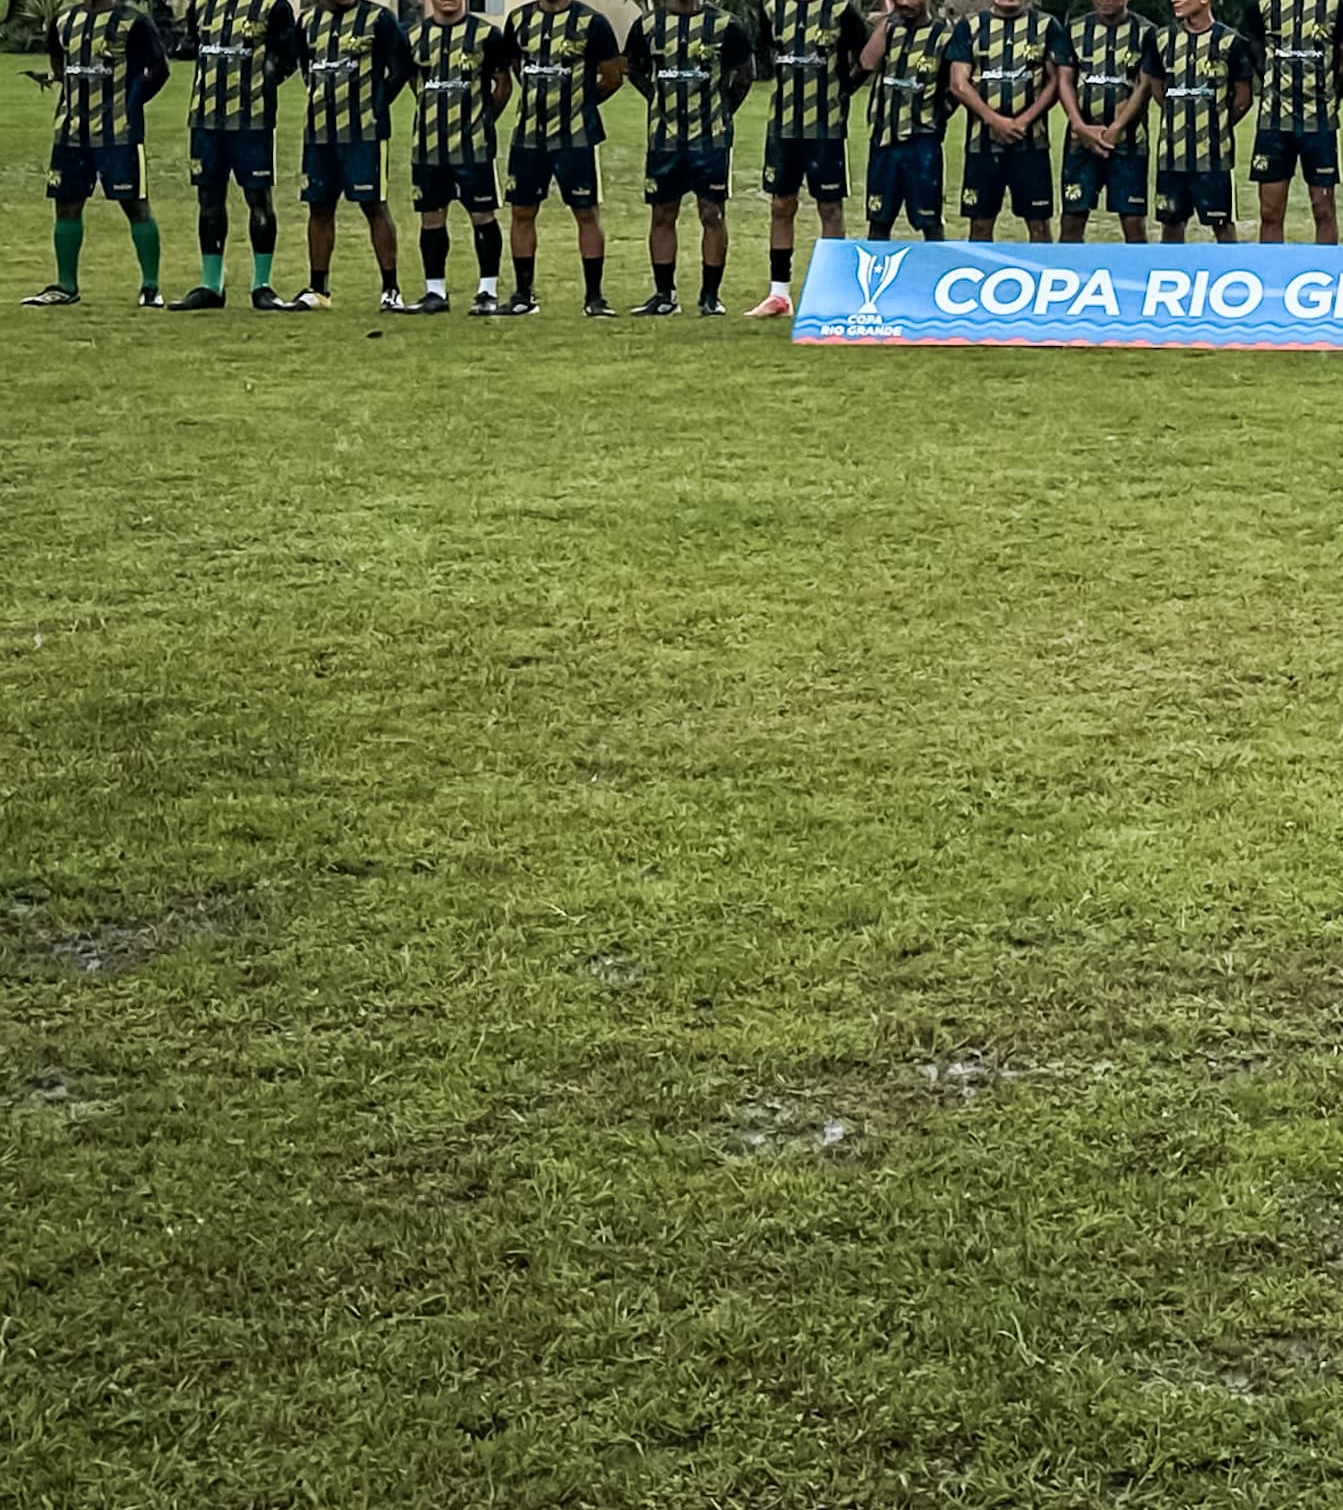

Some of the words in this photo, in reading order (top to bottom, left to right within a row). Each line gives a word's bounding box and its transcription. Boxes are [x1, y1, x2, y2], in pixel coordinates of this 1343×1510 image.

[934, 267, 1119, 317] COPA
[1142, 268, 1263, 318] RIO
[847, 314, 883, 325] COPA
[820, 325, 844, 336] RIO
[847, 325, 903, 337] GRANDE
